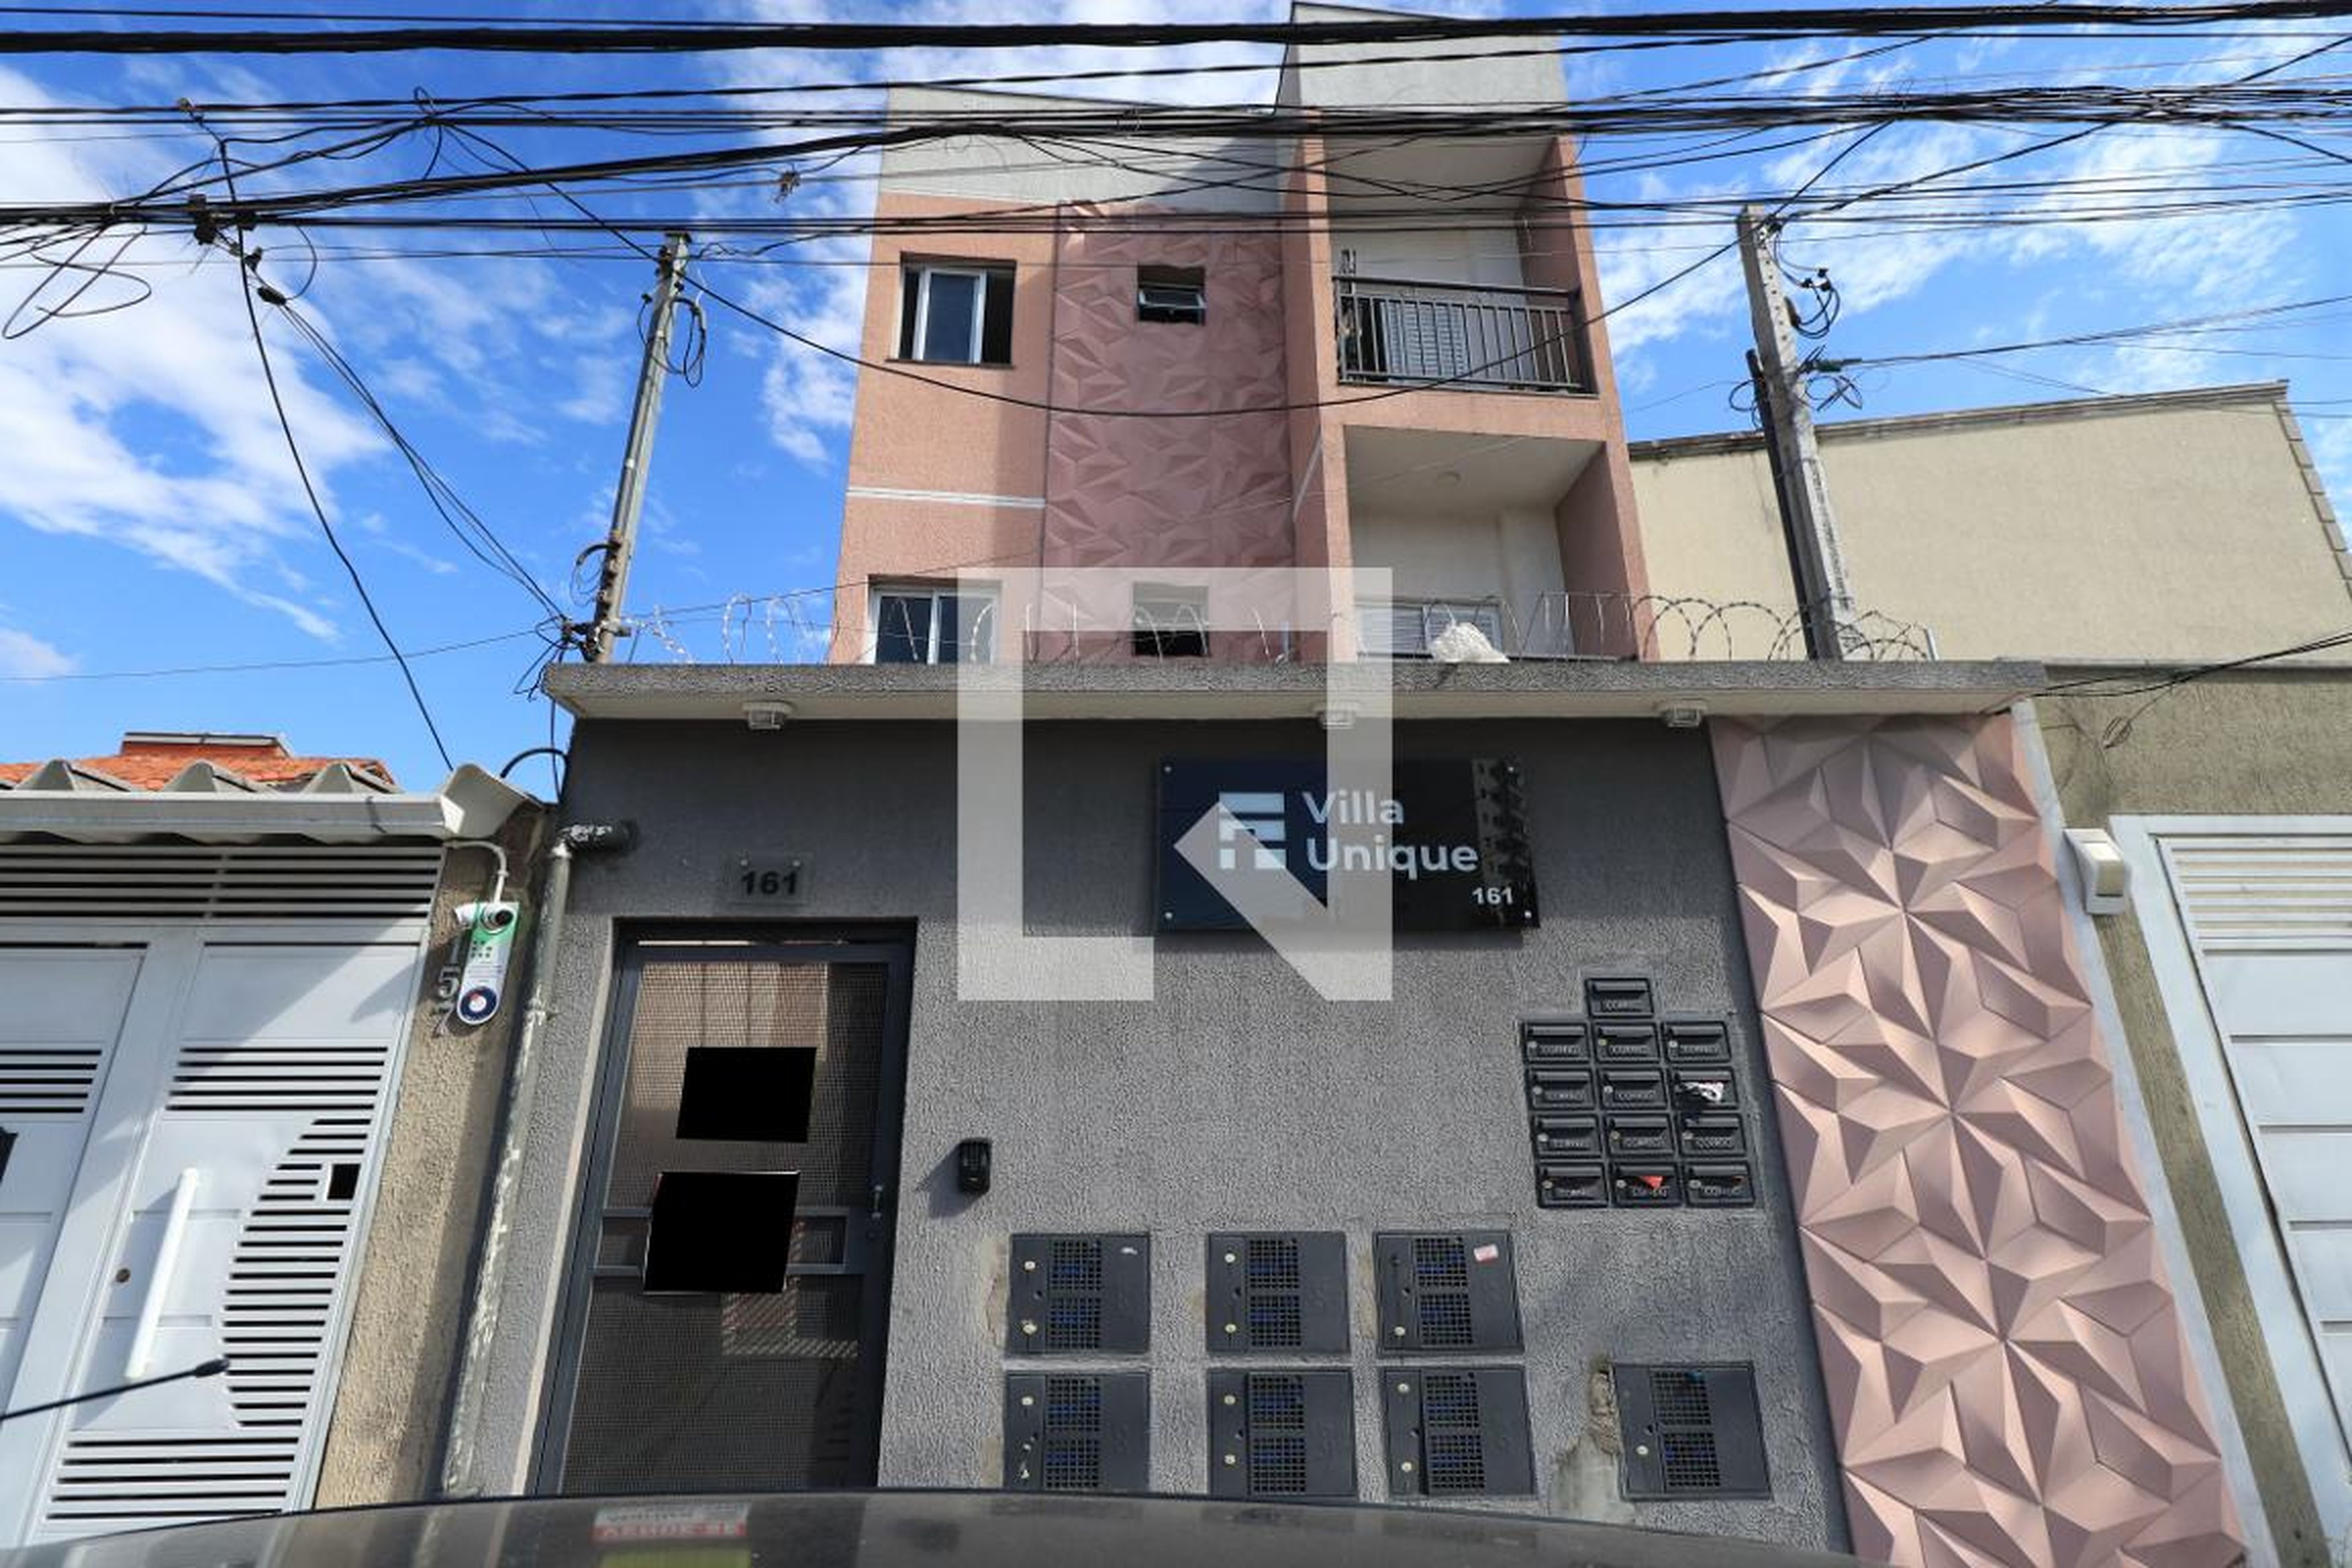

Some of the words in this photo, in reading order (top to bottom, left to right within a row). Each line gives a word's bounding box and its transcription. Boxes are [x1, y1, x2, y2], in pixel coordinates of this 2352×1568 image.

[1303, 790, 1404, 824] Villa
[1306, 834, 1479, 880] Unique
[741, 871, 797, 895] 161
[1472, 887, 1512, 905] 161
